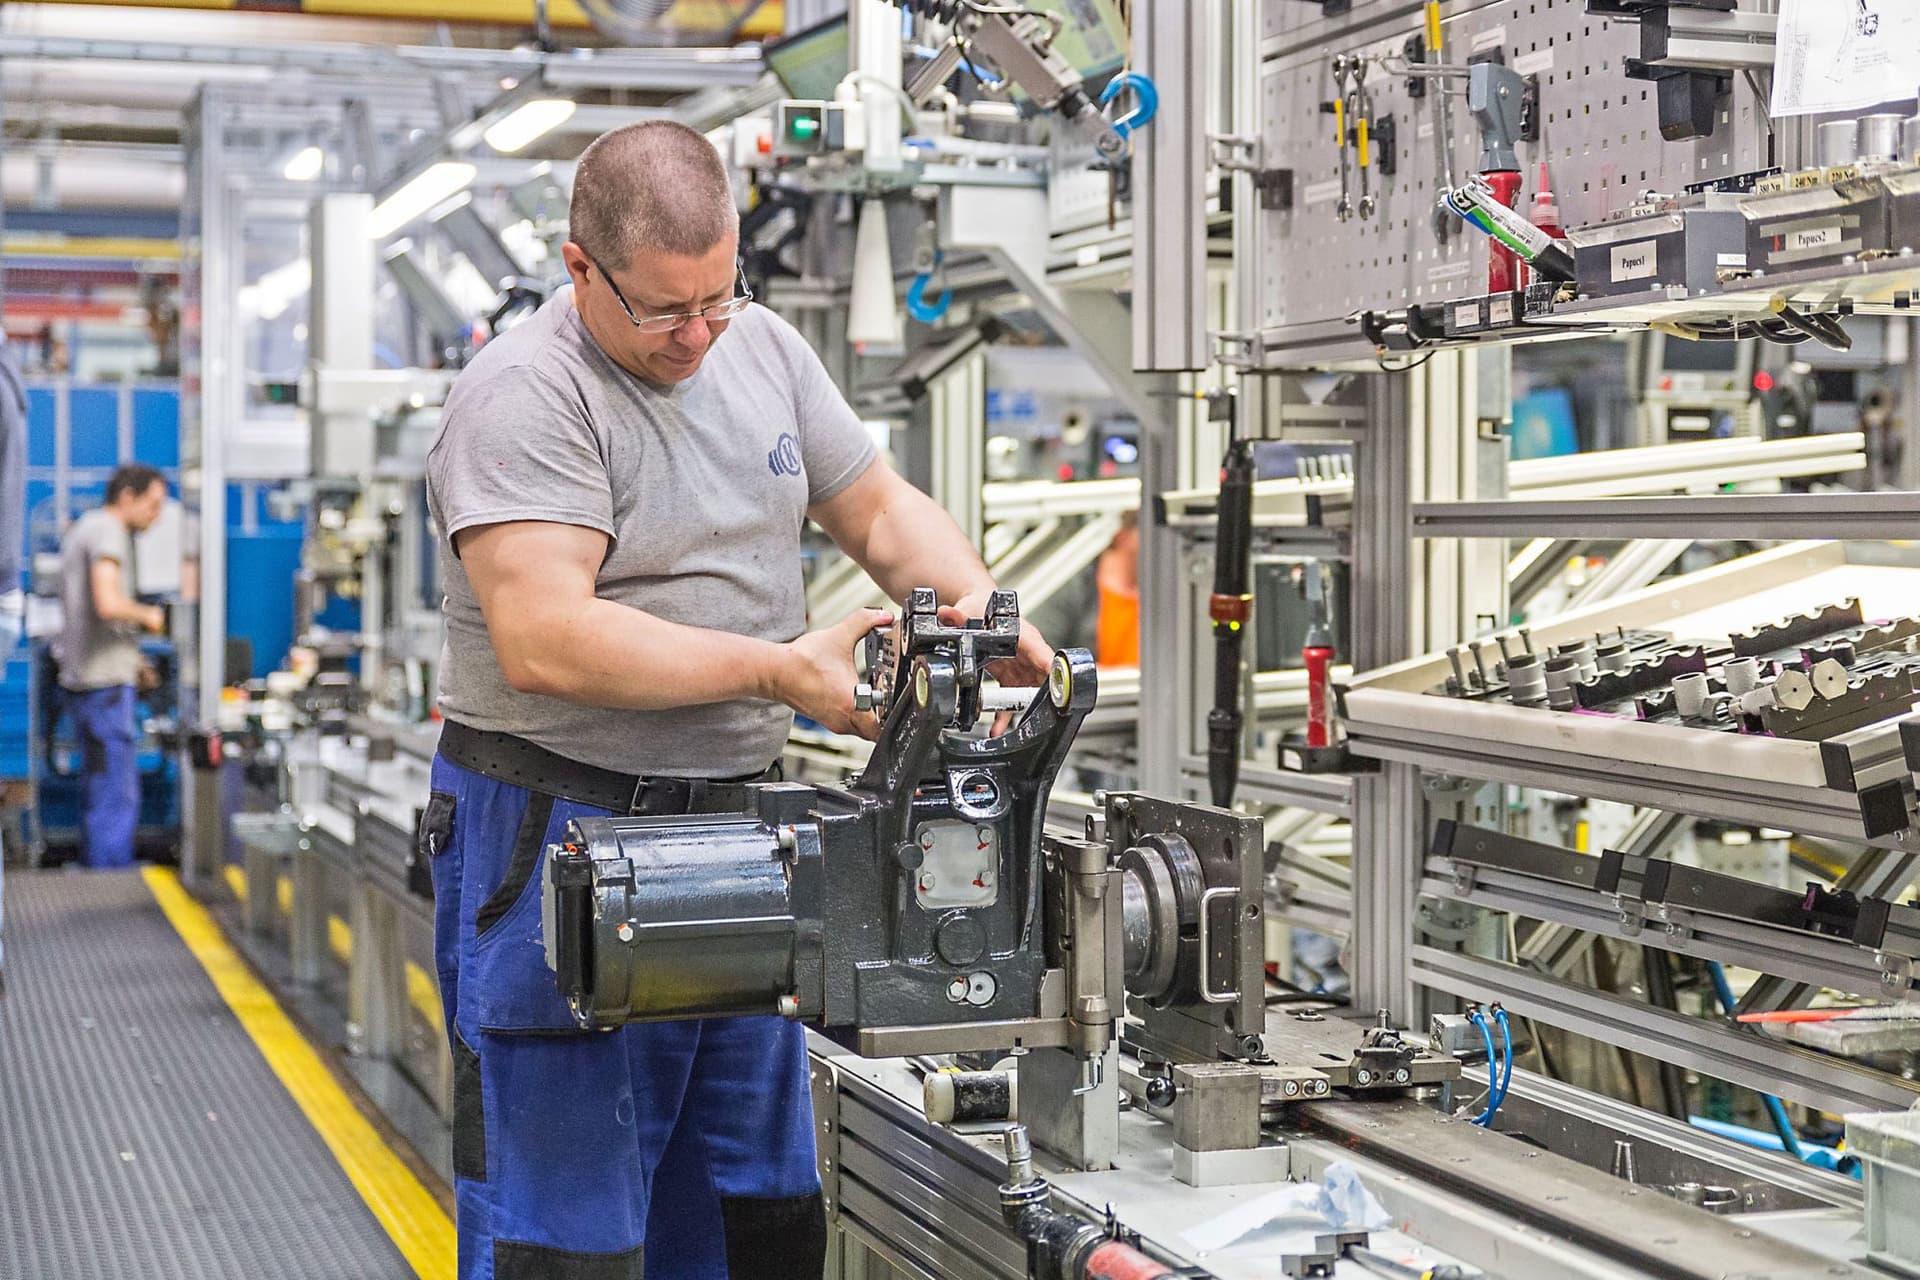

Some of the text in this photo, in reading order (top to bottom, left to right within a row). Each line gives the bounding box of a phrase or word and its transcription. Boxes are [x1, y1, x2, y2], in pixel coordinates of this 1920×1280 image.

[1738, 176, 1745, 187] 3
[1798, 231, 1826, 246] Papucs2
[1622, 256, 1645, 270] Papucs1
